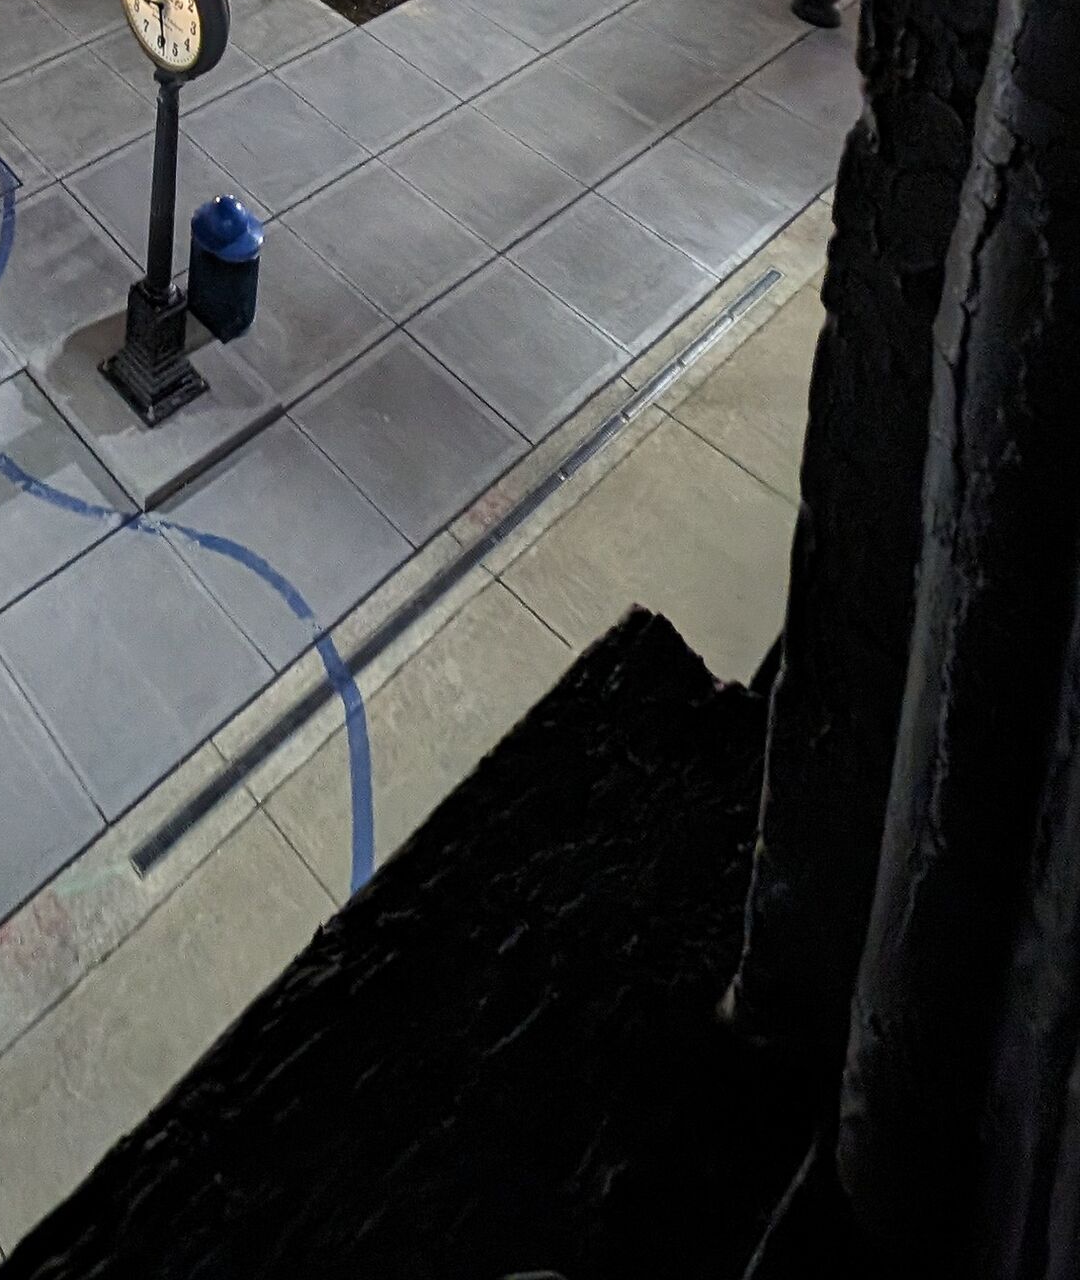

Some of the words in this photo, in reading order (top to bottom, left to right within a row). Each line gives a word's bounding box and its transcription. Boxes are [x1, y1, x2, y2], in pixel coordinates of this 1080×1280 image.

[143, 19, 150, 32] 7
[190, 22, 197, 36] 3
[172, 42, 179, 57] 5
[184, 38, 191, 51] 4
